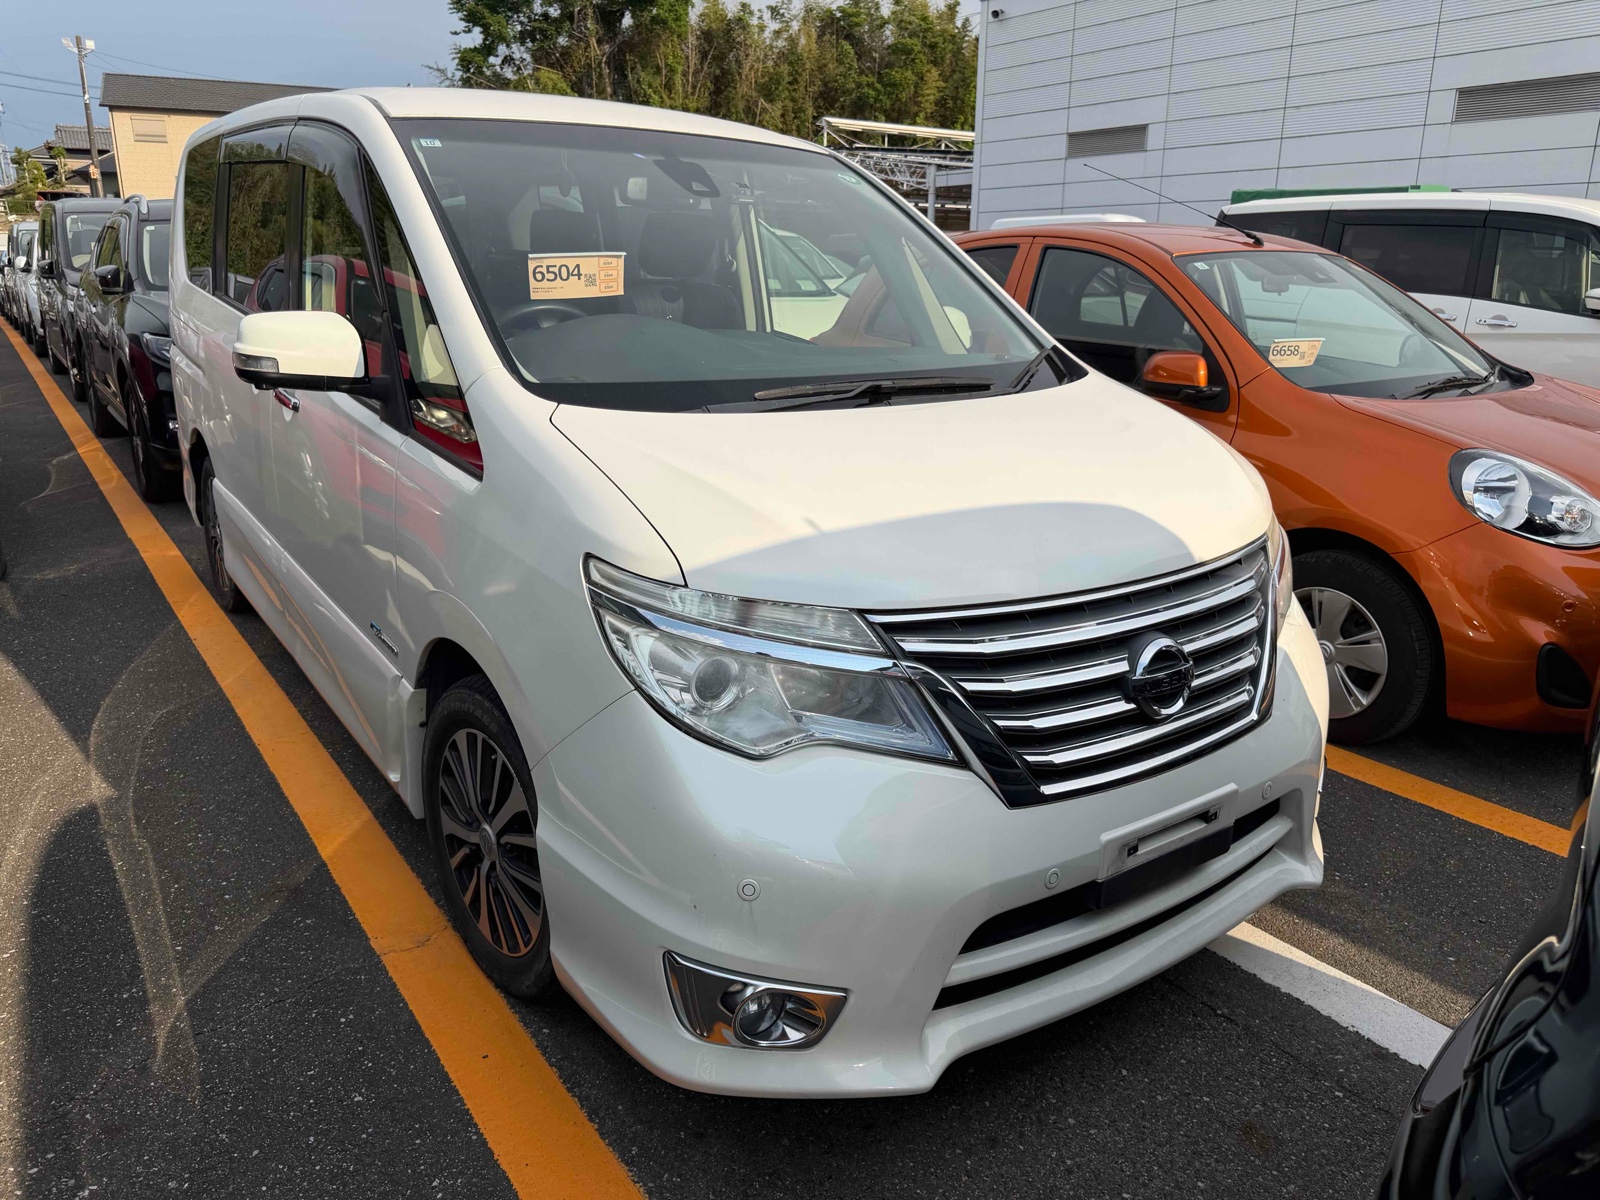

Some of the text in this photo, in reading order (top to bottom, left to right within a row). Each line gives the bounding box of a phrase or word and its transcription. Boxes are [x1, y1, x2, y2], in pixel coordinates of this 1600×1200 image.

[532, 263, 582, 283] 6504
[1271, 345, 1300, 357] 6658
[1142, 665, 1193, 694] NISSAN
